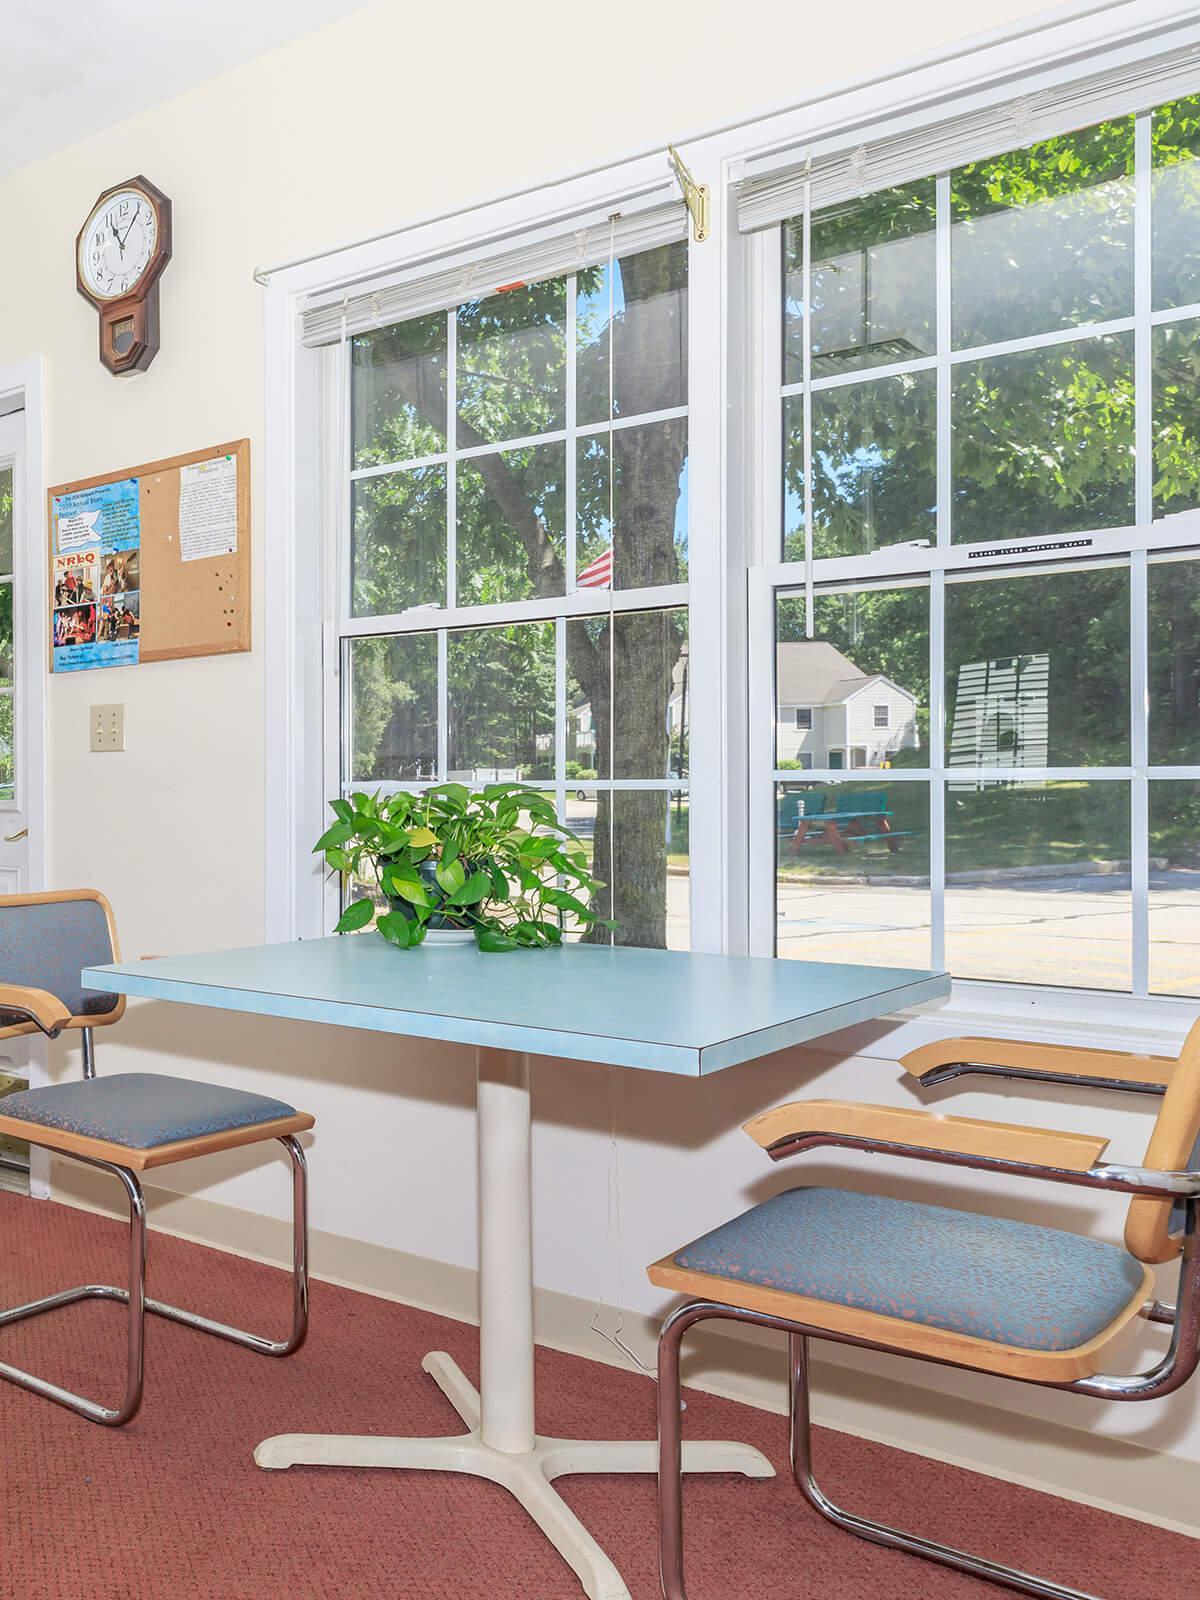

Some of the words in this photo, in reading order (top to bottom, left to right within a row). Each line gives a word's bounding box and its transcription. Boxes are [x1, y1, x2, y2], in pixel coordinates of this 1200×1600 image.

[120, 201, 128, 217] 12
[146, 211, 152, 226] 2
[96, 232, 105, 247] 10
[93, 251, 100, 265] 9
[97, 267, 103, 281] 8
[107, 278, 114, 291] 7
